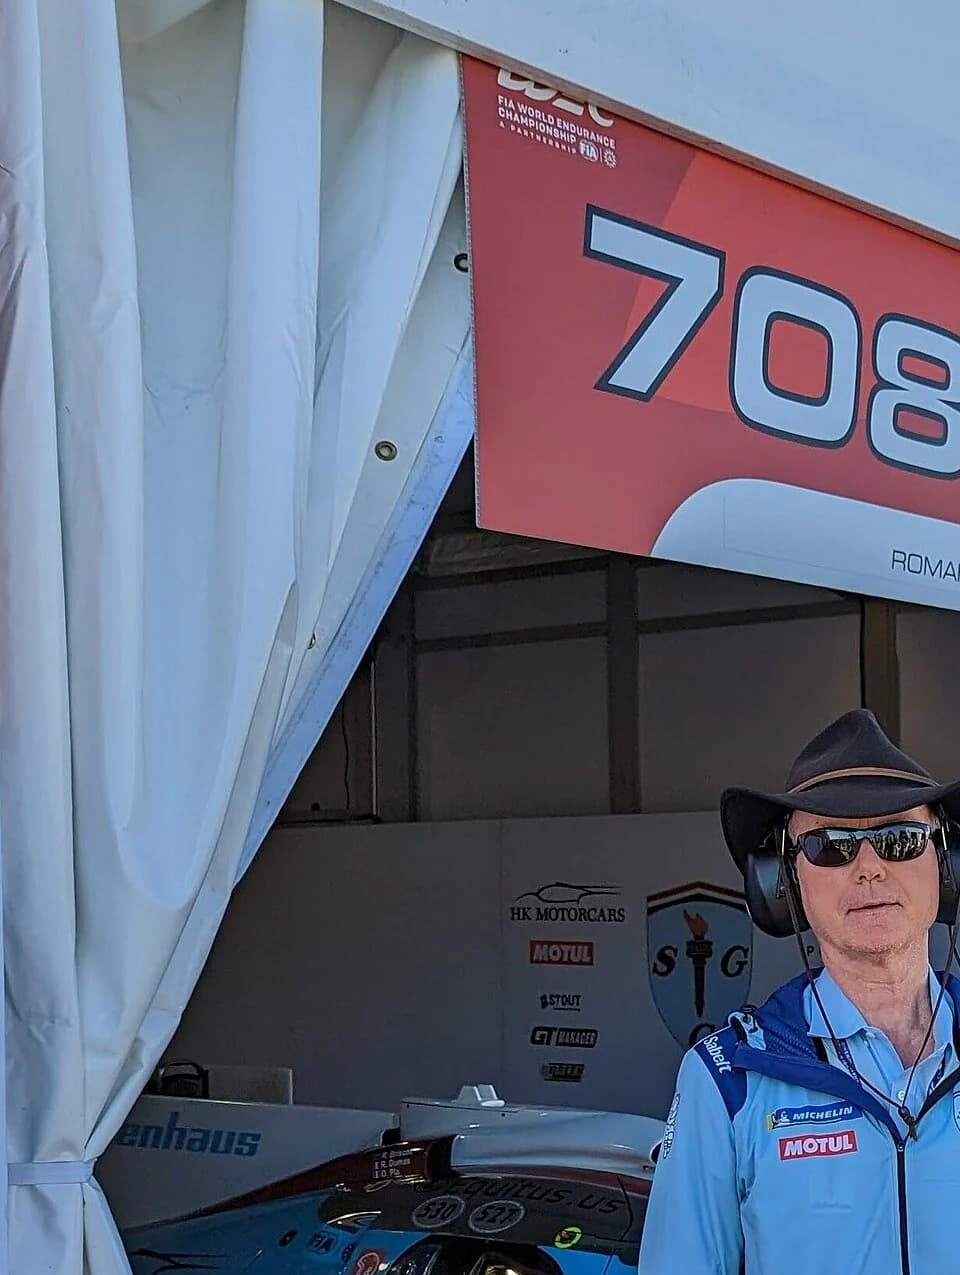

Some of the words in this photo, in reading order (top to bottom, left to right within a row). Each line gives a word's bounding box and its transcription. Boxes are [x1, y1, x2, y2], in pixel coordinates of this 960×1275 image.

[498, 95, 515, 110] FIA
[517, 102, 555, 125] WORLD
[556, 119, 616, 149] ENDURANCE
[498, 107, 577, 144] CHAMPIONSHIP
[510, 907, 532, 922] HK
[536, 907, 626, 922] MOTORCARS
[532, 943, 592, 963] MOTUL
[652, 945, 678, 977] S
[720, 945, 749, 977] G
[703, 1035, 732, 1074] Sabelt
[792, 1106, 853, 1121] MICHELIN
[784, 1134, 853, 1157] MOTUL
